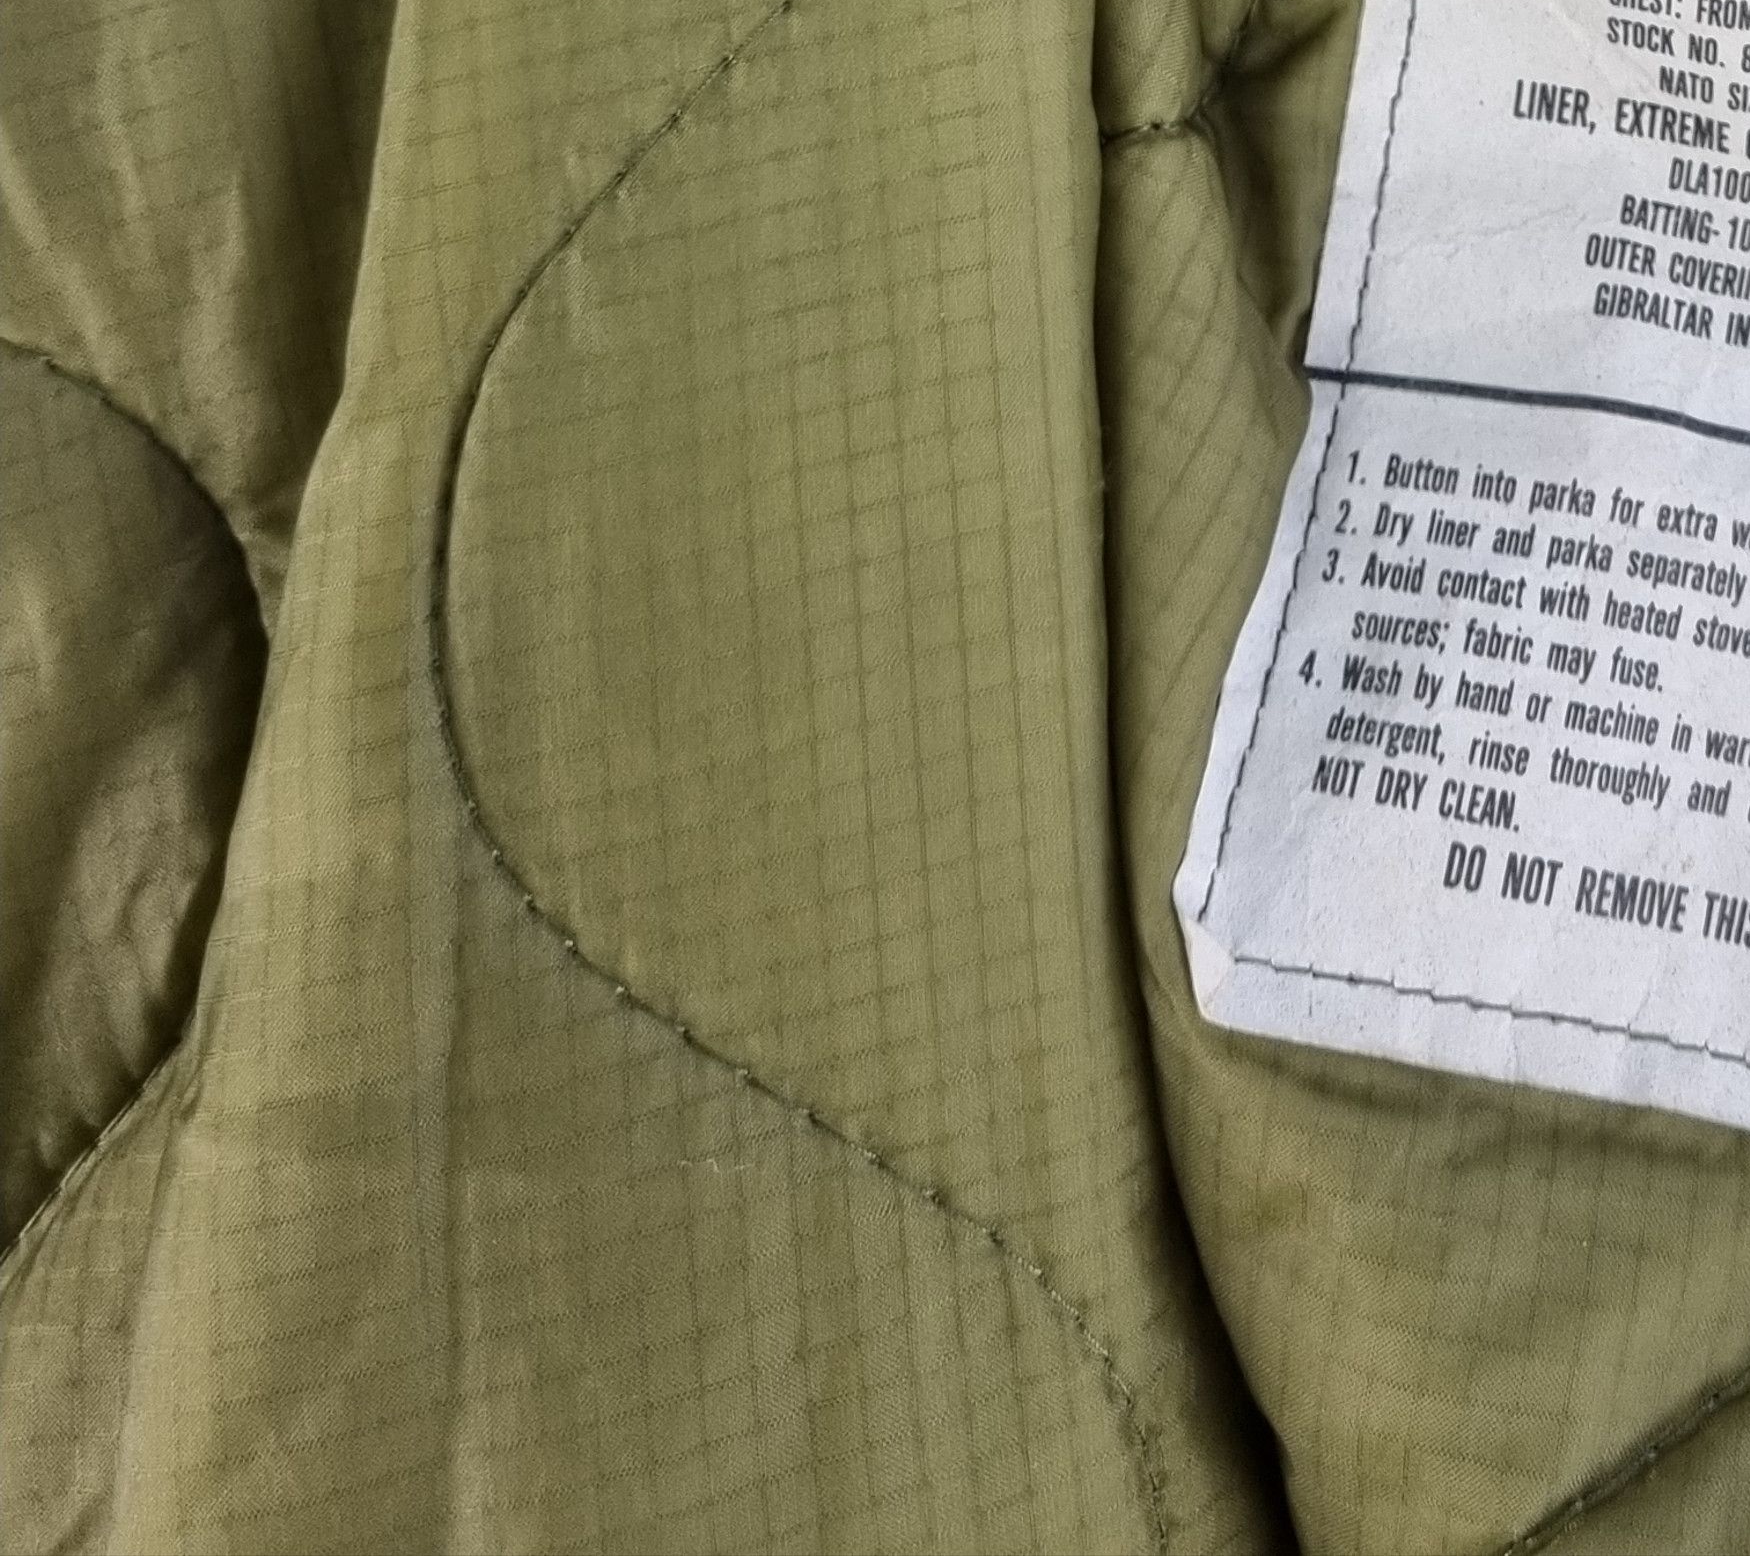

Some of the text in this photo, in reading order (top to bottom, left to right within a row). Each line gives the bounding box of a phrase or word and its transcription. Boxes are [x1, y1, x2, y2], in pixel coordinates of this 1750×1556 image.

[1606, 16, 1675, 56] STOCK
[1688, 33, 1725, 68] NO.
[1512, 78, 1597, 135] LINER,
[1614, 97, 1730, 154] EXTREME
[1659, 65, 1714, 104] NATO
[1592, 282, 1714, 340] GIBRALTAR
[1348, 449, 1366, 485] 1.
[1383, 453, 1460, 495] Button
[1472, 469, 1518, 505] into
[1528, 478, 1596, 518] parka
[1609, 486, 1645, 528] for
[1656, 503, 1718, 542] extra
[1334, 499, 1357, 535] 2.
[1373, 502, 1414, 547] Dry
[1426, 509, 1481, 549] liner
[1492, 523, 1536, 559] and
[1546, 534, 1614, 573] parka
[1626, 550, 1747, 608] separately
[1321, 547, 1345, 585] 3.
[1360, 551, 1427, 594] Avoid
[1437, 569, 1527, 611] contact
[1539, 584, 1591, 622] with
[1603, 590, 1683, 641] heated
[1351, 611, 1663, 693] sources; fabric may fuse.
[1311, 755, 1520, 833] NOT DRY CLEAN.
[1442, 841, 1487, 893] DO
[1501, 852, 1564, 907] NOT
[1574, 866, 1690, 934] REMOVE
